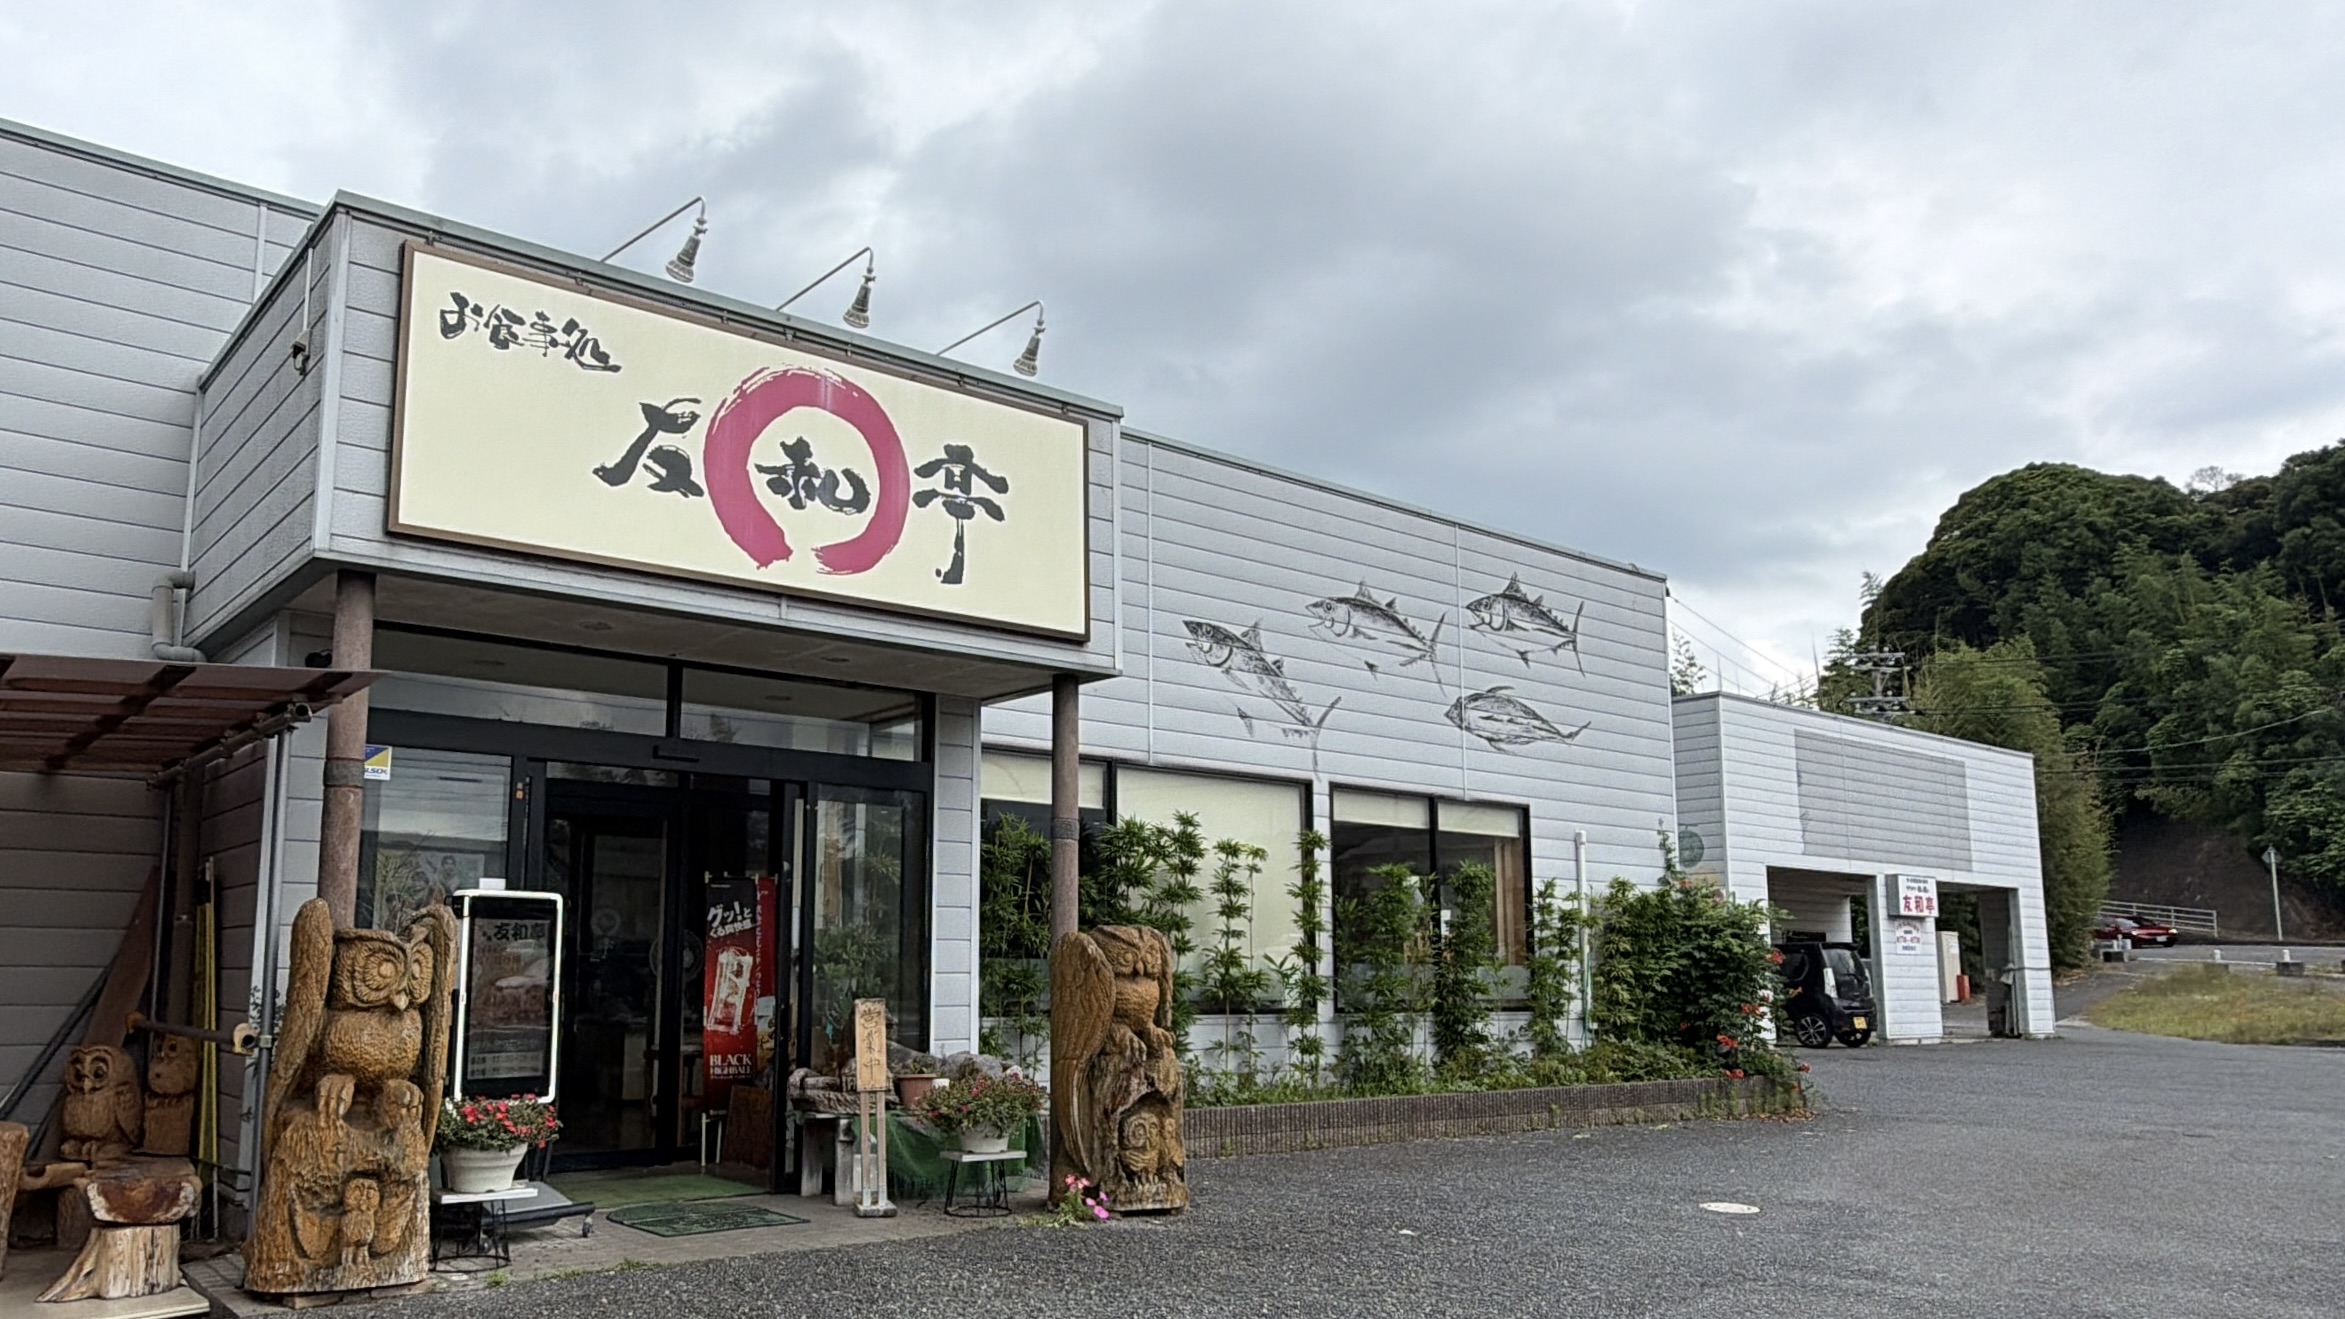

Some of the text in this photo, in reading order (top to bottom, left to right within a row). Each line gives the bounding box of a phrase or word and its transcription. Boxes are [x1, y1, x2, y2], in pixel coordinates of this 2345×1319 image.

[440, 291, 621, 372] お食事処
[592, 397, 1009, 585] 友和亭
[1903, 894, 1935, 914] 友和亭
[709, 1053, 752, 1066] BLACK
[860, 1005, 882, 1082] 営業中
